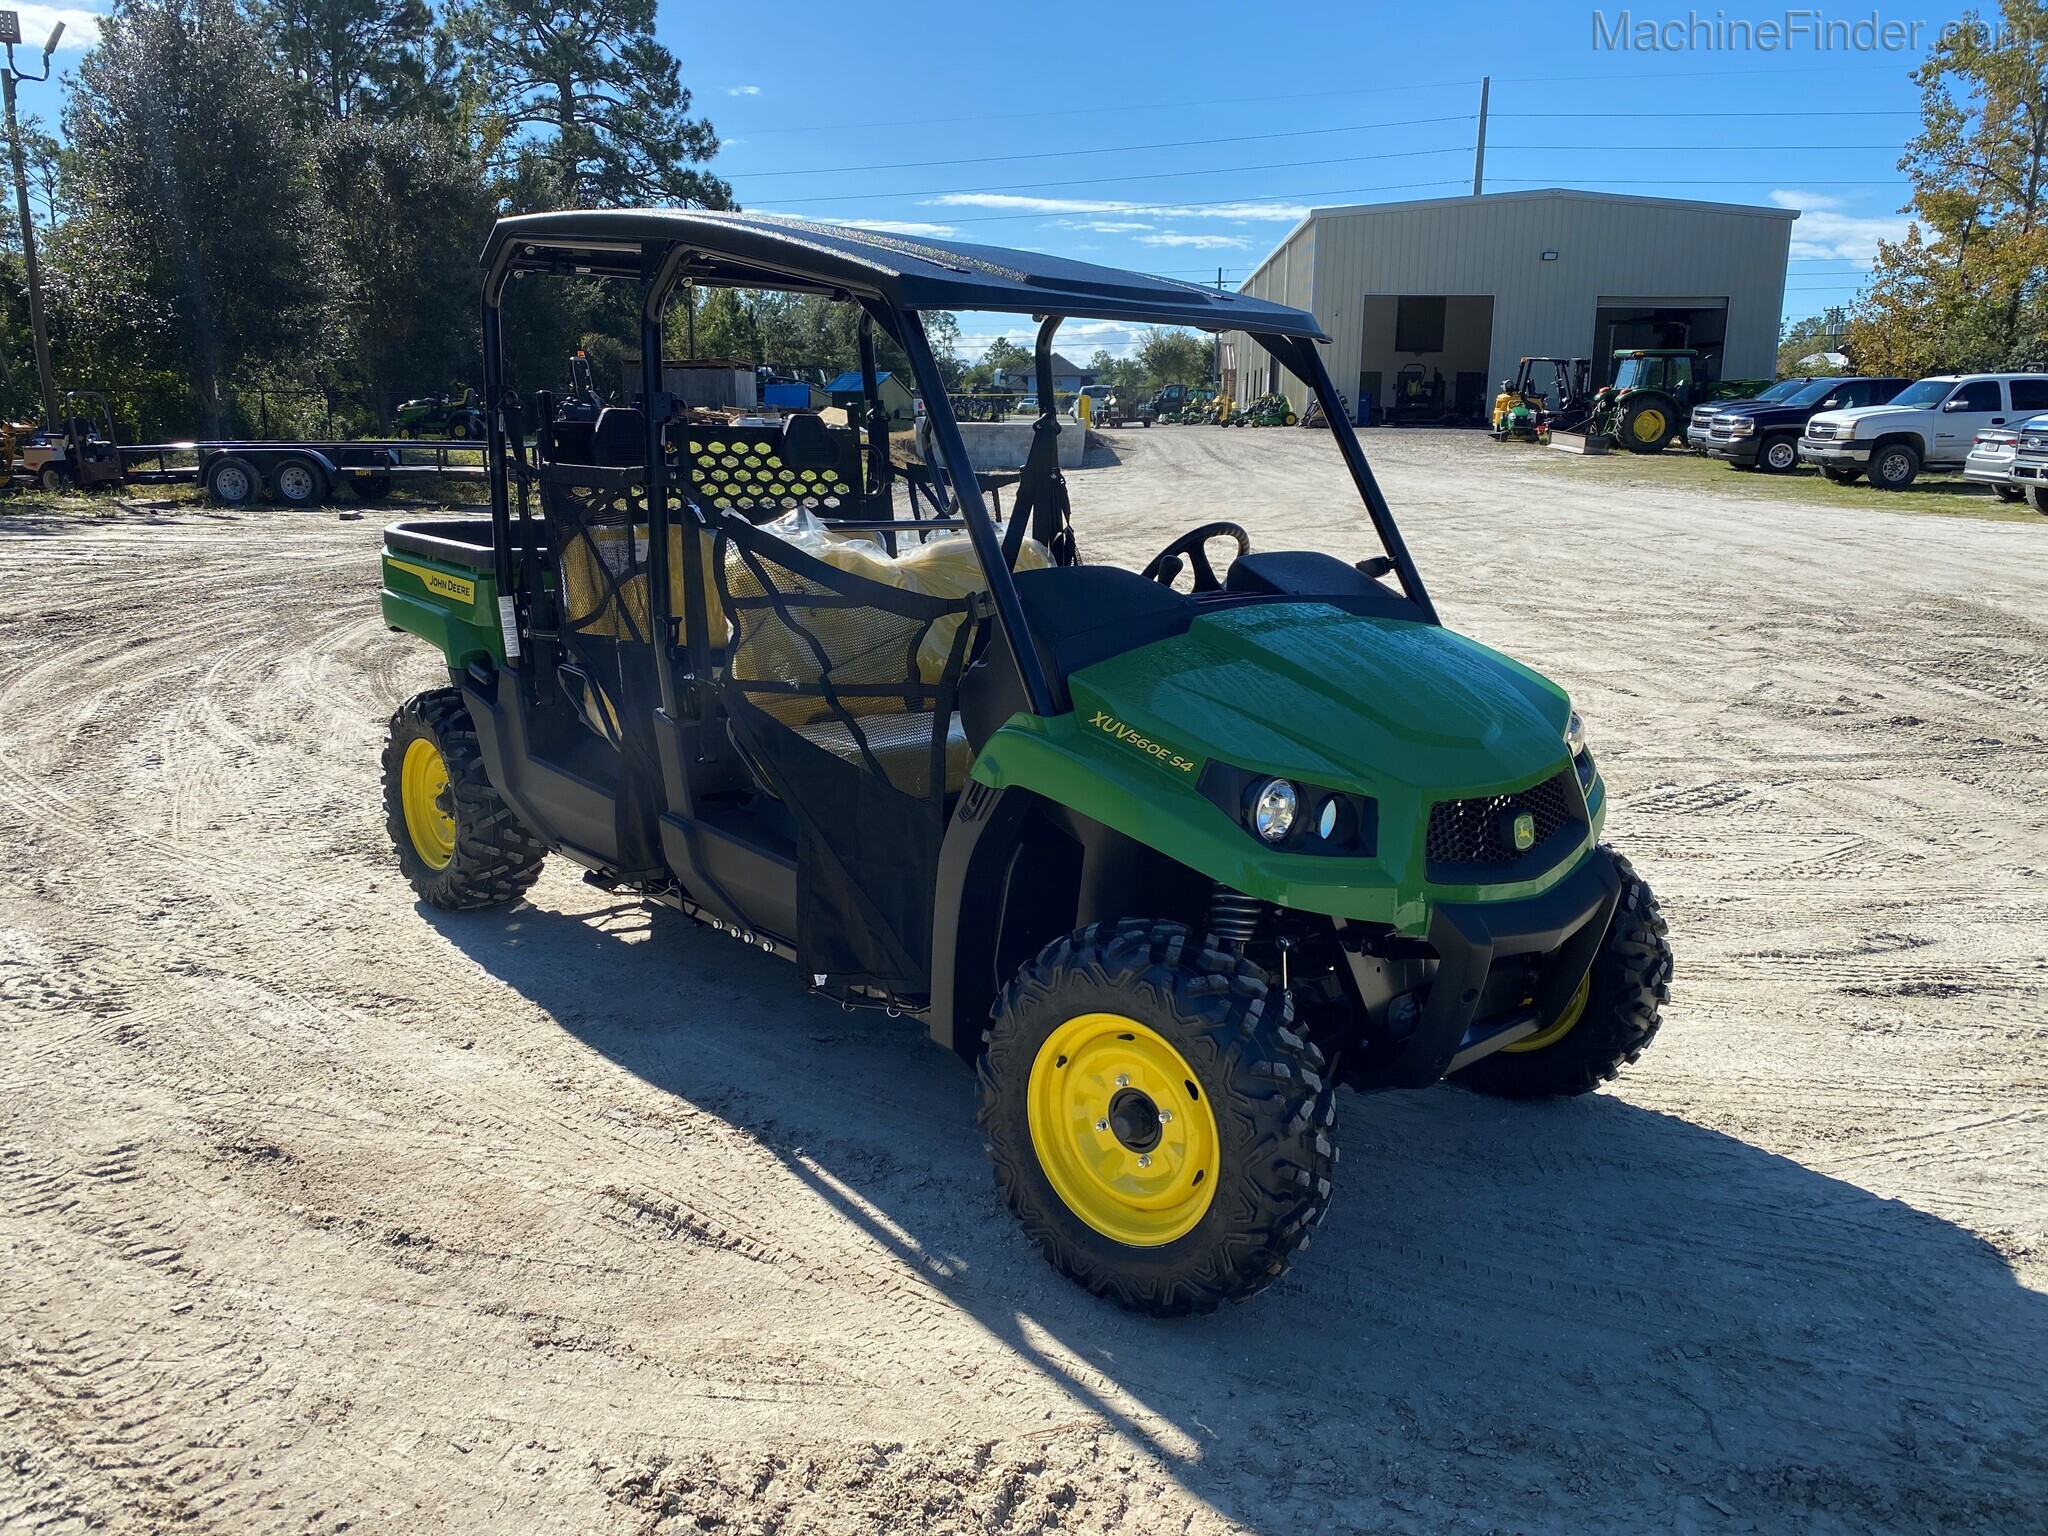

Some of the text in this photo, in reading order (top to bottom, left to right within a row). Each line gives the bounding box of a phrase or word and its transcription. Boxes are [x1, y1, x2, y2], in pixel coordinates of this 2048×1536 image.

[430, 575, 470, 596] JOHN DEERE
[1088, 711, 1194, 772] XUV560E S4
